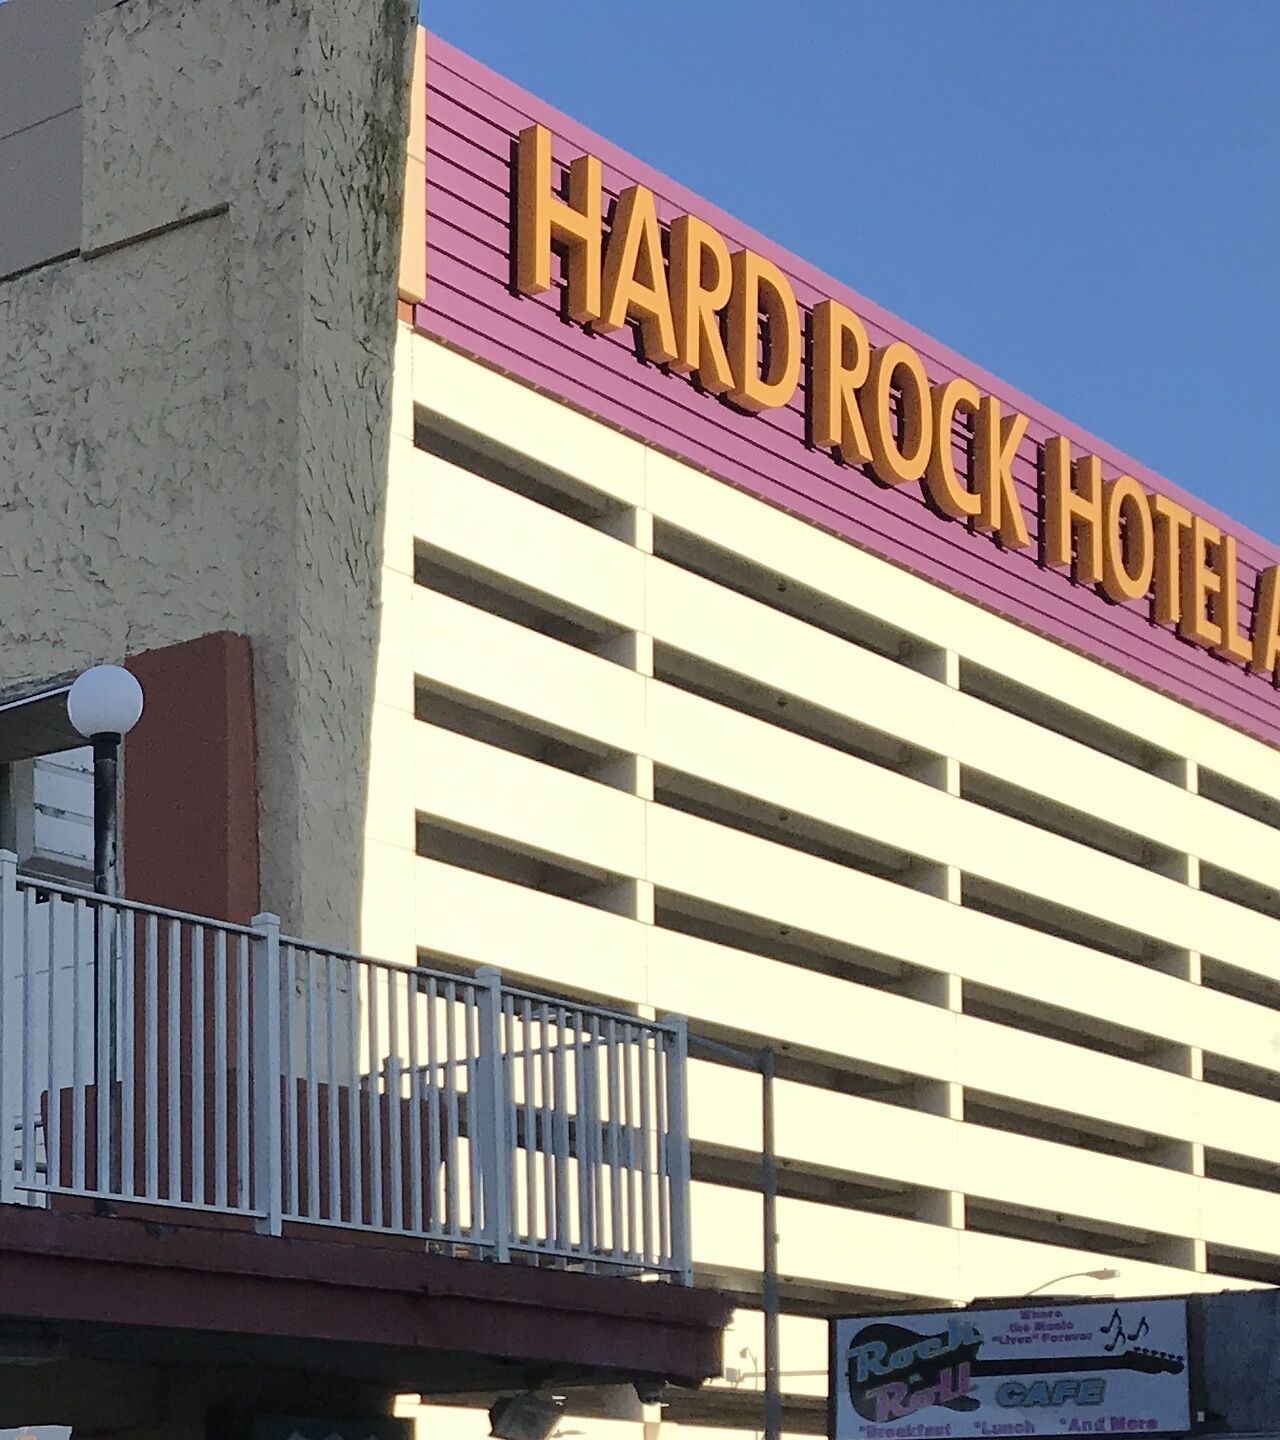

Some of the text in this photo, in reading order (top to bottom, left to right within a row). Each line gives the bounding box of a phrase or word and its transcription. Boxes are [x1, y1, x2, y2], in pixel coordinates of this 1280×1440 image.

[518, 123, 802, 412] HARD
[813, 298, 1031, 552] ROCK
[1044, 433, 1253, 662] HOTEL
[845, 1317, 984, 1383] Rock
[866, 1360, 973, 1423] Roll
[995, 1377, 1107, 1408] CAFE
[1110, 1415, 1159, 1431] More
